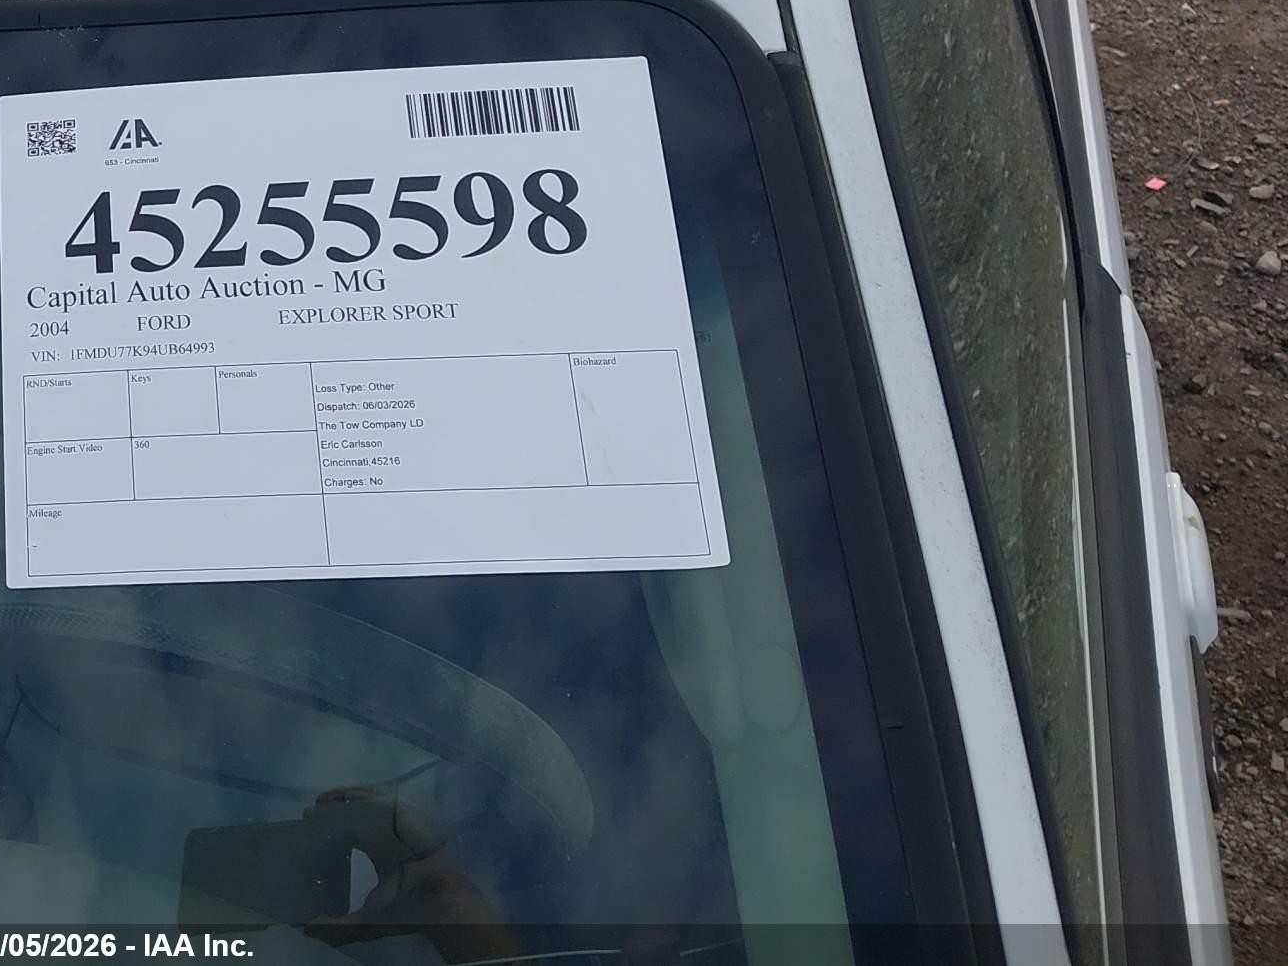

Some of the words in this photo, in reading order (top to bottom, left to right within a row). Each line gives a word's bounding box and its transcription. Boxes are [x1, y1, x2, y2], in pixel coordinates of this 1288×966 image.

[124, 156, 159, 165] Cincinnati
[65, 168, 589, 274] 45255598
[27, 281, 116, 313] Capital
[127, 280, 190, 303] Auto
[200, 273, 306, 299] Auction
[332, 268, 386, 293] MG
[278, 305, 388, 325] EXPLORER
[392, 303, 459, 320] SPORT
[29, 320, 70, 338] 2004
[136, 314, 191, 332] FORD
[31, 350, 60, 363] VIN:
[71, 341, 216, 361] 1FMDU77K94UB64993
[573, 356, 617, 366] Biohazard
[130, 373, 152, 385] Keys
[218, 369, 258, 379] Personals
[26, 378, 73, 389] RND/Starts
[315, 384, 337, 393] Loss
[340, 382, 366, 394] Type:
[368, 381, 396, 391] Other
[316, 401, 361, 413] Dispatch:
[362, 400, 416, 410] 06/03/2026
[319, 421, 337, 430] The
[340, 421, 360, 430] Tow
[361, 419, 407, 431] Company
[409, 418, 424, 428] LD
[27, 446, 55, 457] Engine
[58, 444, 76, 454] Start
[78, 442, 103, 453] Video
[134, 440, 150, 449] 360
[320, 440, 340, 449] Eric
[341, 438, 383, 449] Carlsson
[324, 477, 367, 489] Charges:
[369, 476, 384, 486] No
[29, 508, 63, 519] Mileage
